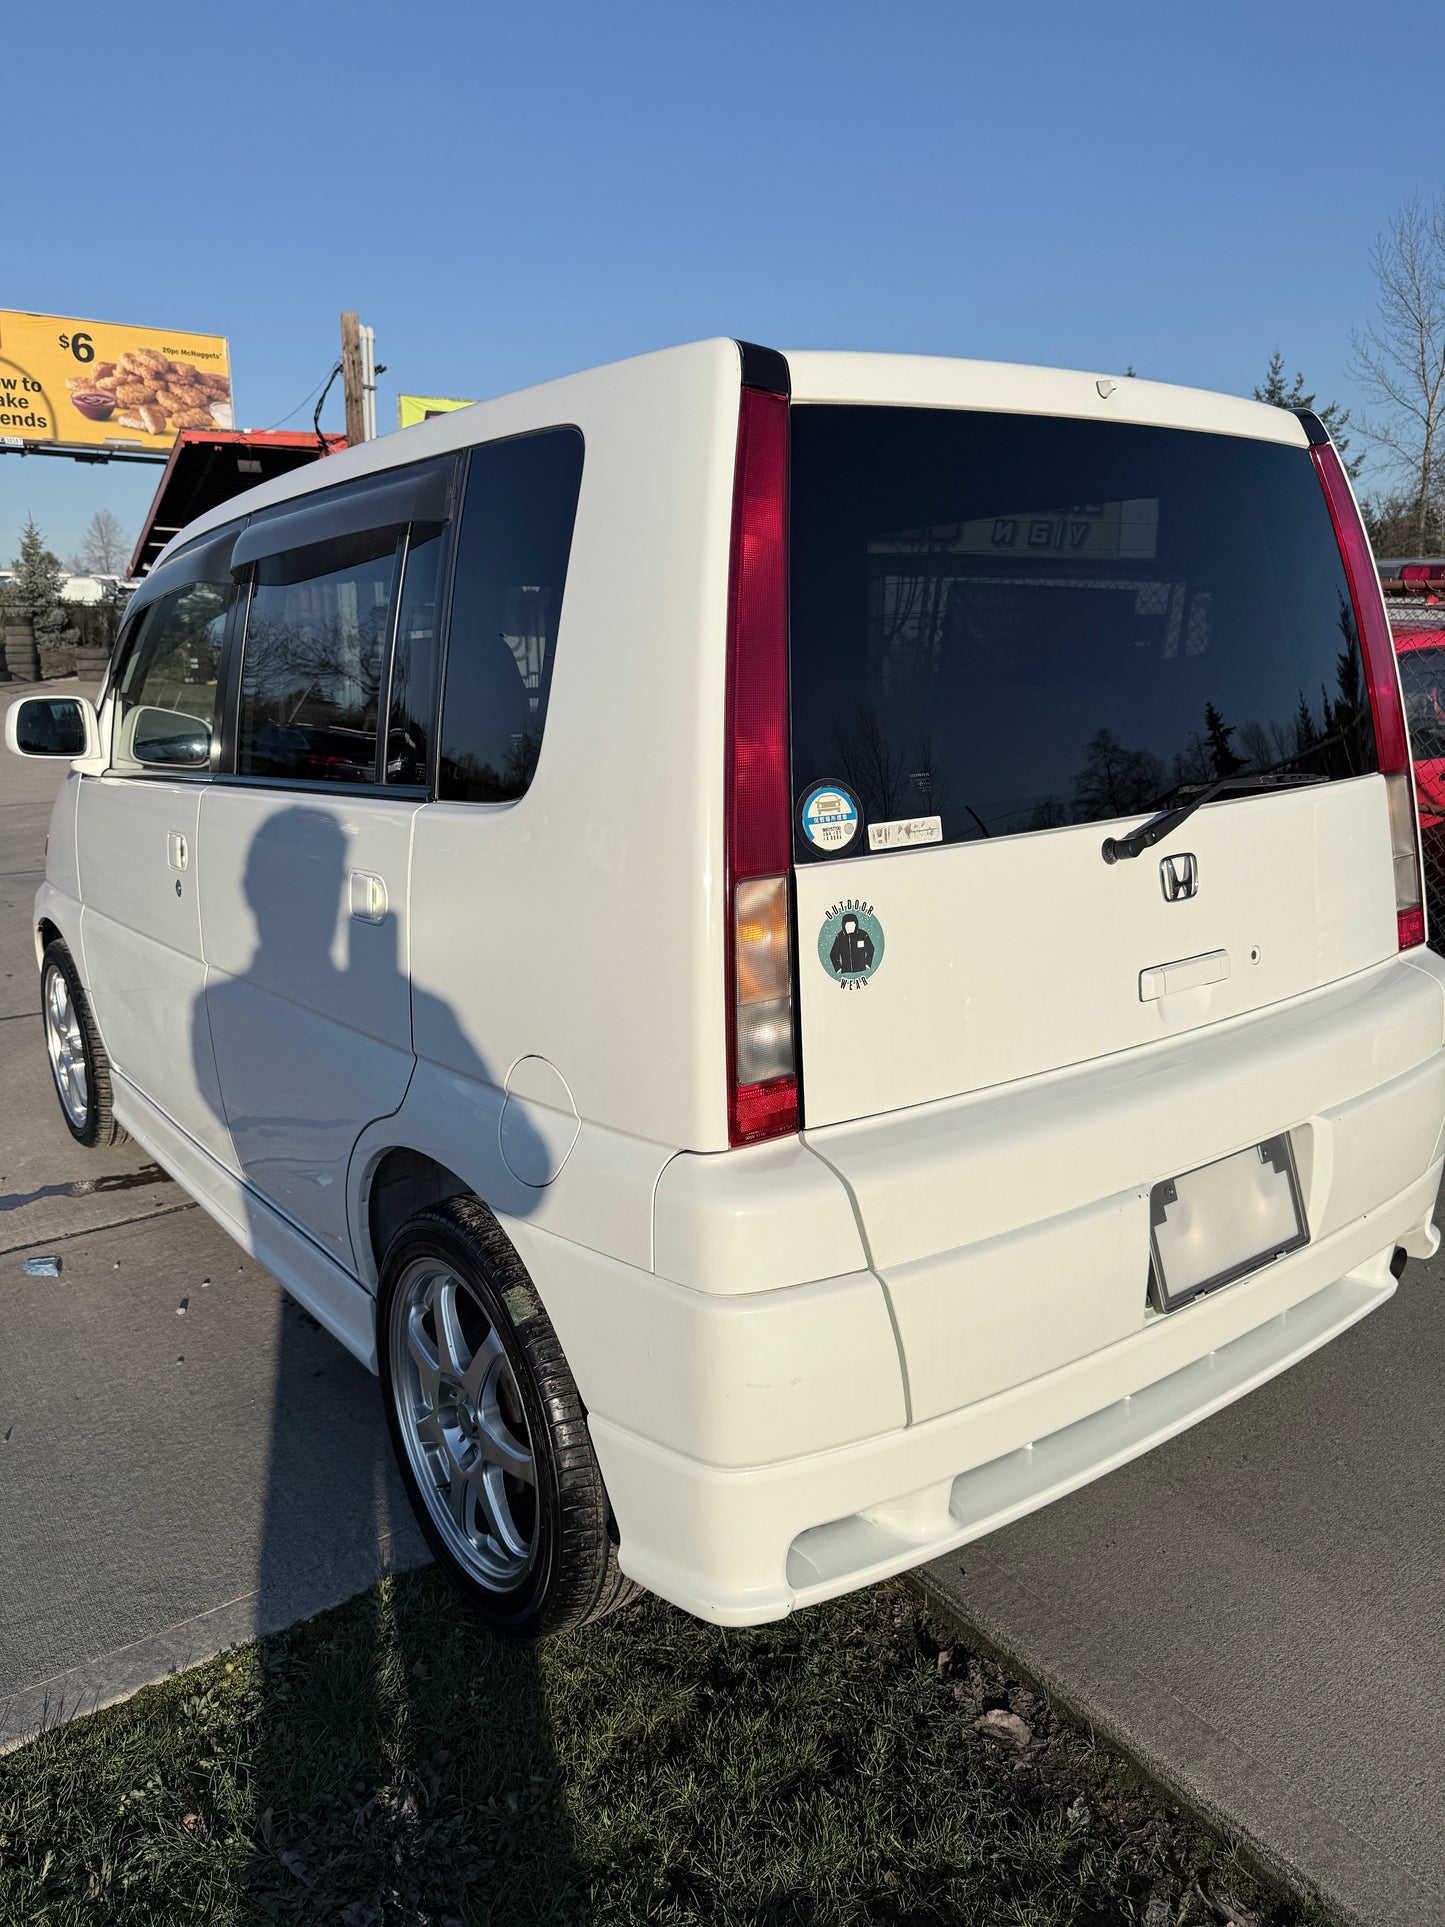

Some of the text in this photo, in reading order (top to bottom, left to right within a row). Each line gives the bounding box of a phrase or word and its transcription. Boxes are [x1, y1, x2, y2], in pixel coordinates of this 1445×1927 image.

[58, 332, 95, 363] $6
[21, 377, 42, 393] to
[825, 899, 874, 920] OUTDOOR
[840, 976, 868, 991] WEAR
